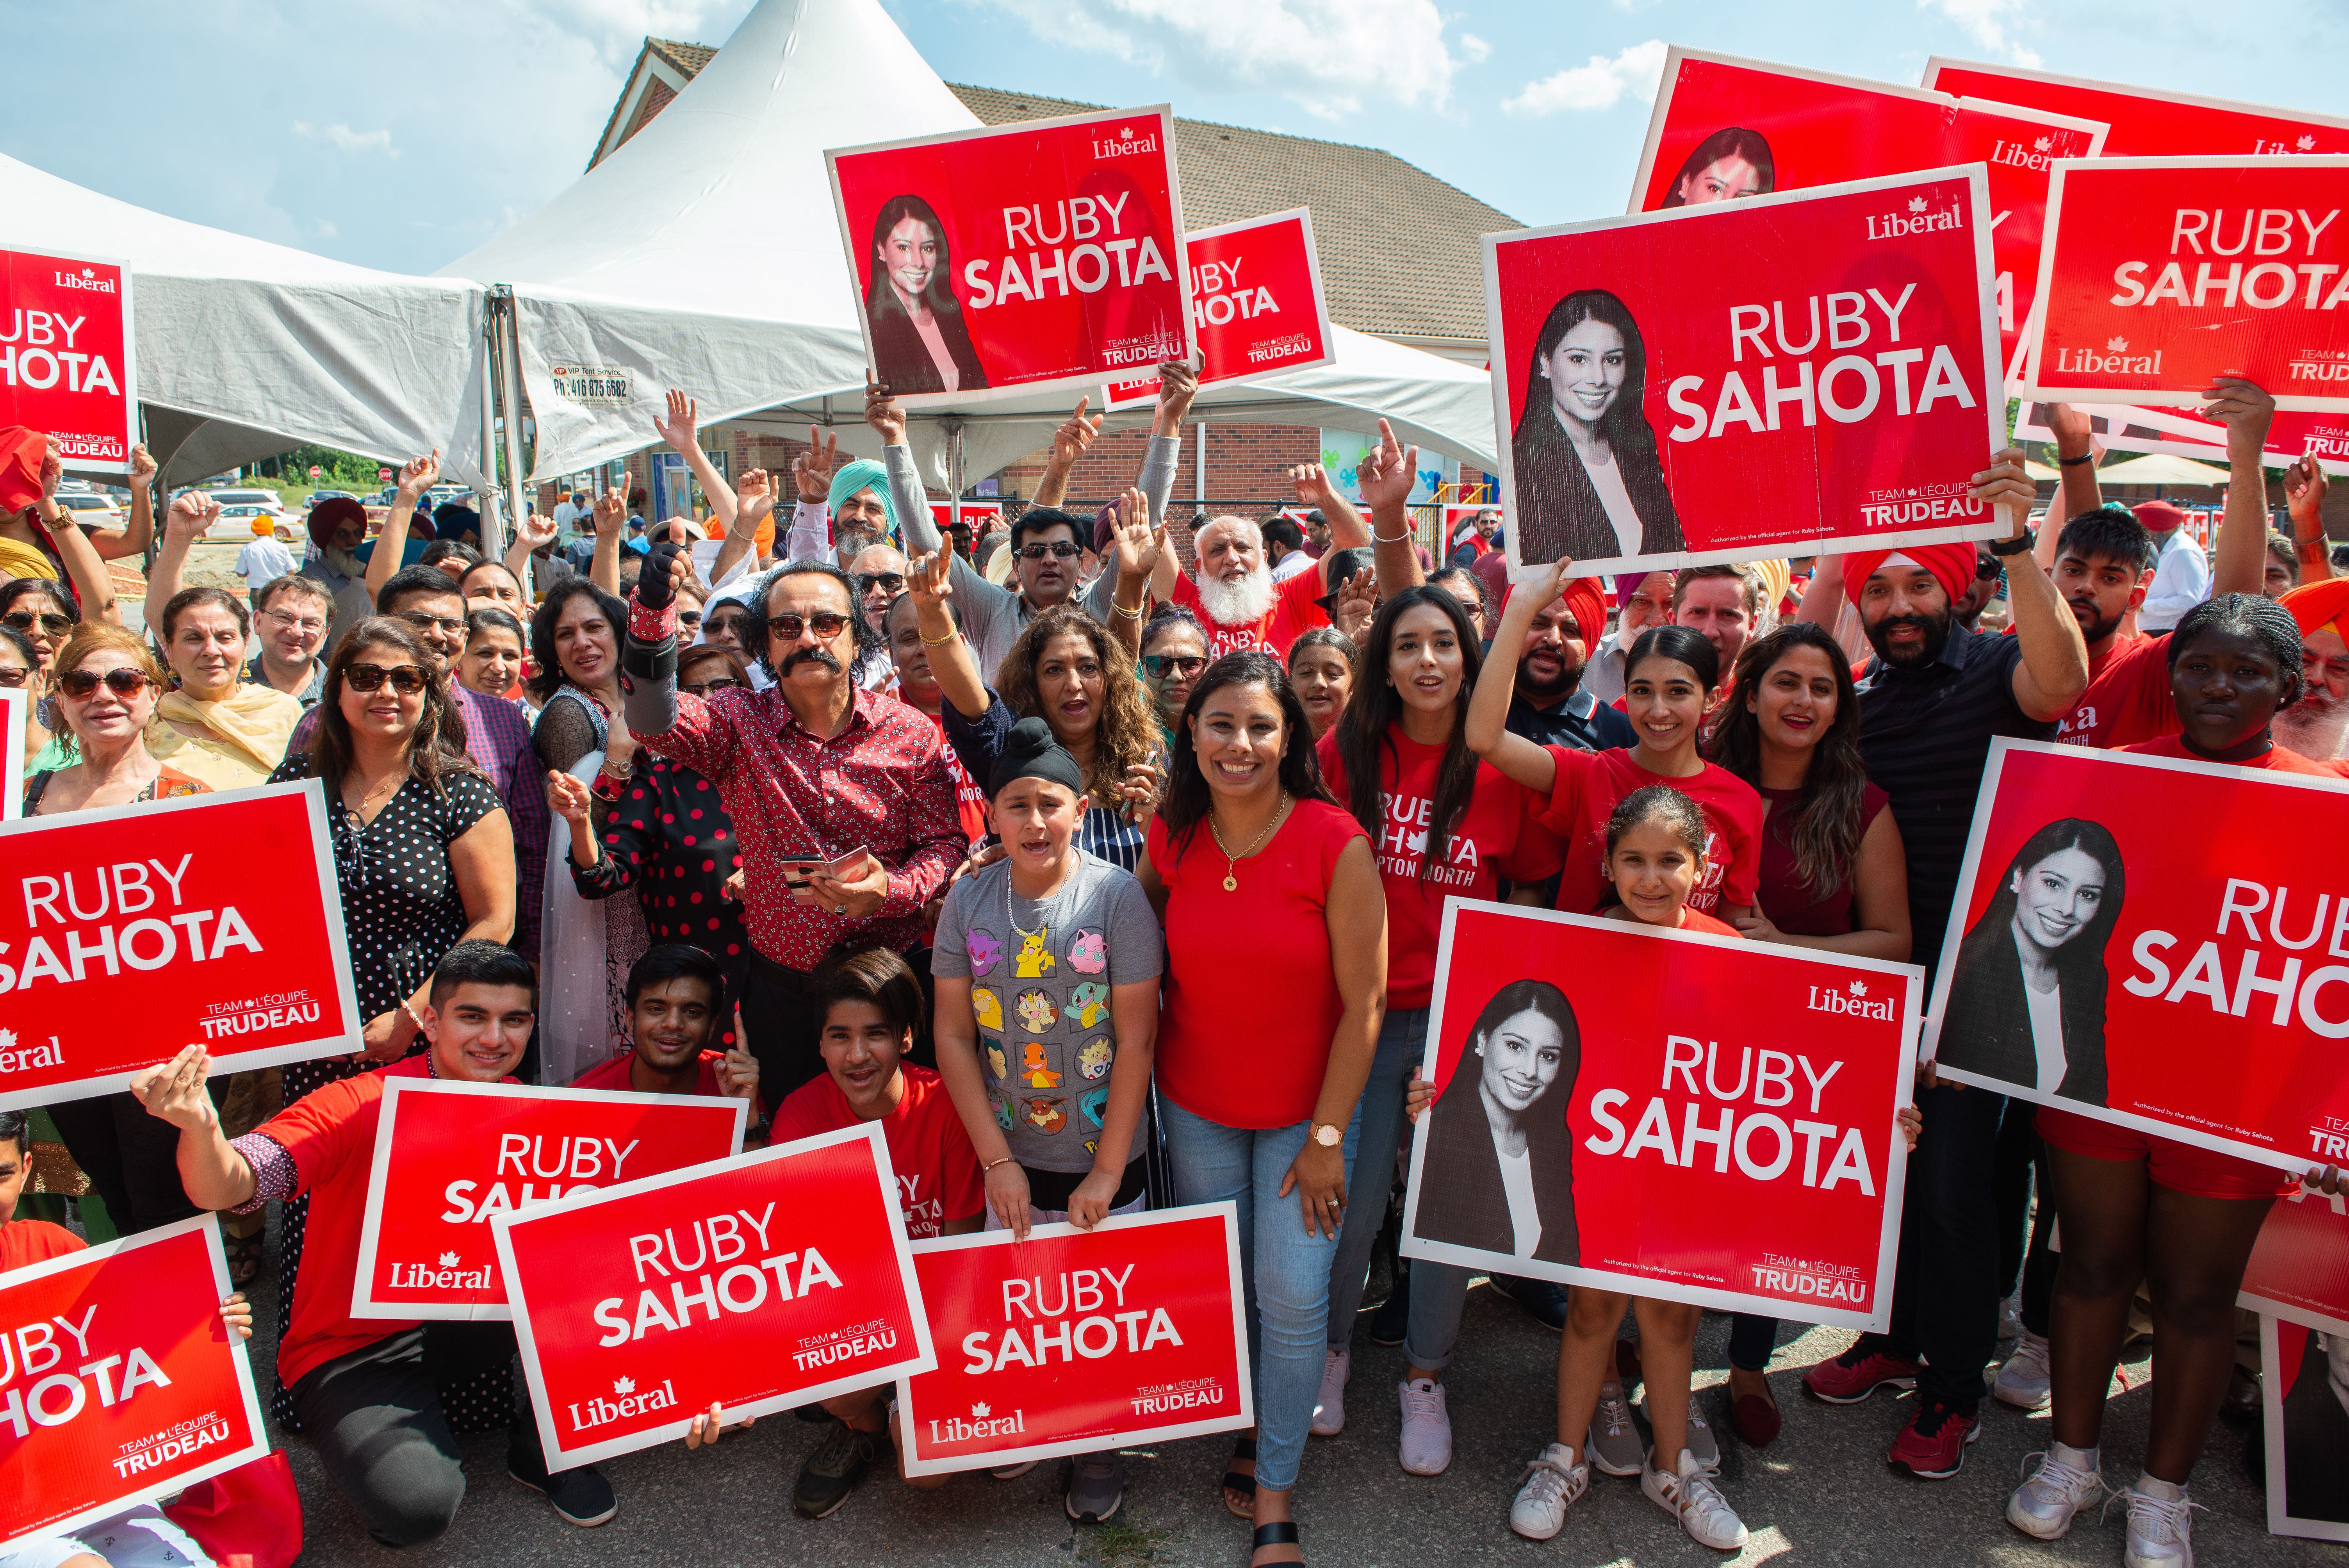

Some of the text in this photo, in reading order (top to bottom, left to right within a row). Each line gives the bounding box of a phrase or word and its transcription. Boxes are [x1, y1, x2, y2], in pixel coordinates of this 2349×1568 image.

[1003, 191, 1129, 249] RUBY
[2171, 209, 2340, 256] RUBY
[965, 236, 1173, 308] SAHOTA
[0, 309, 86, 348] UBY
[1731, 282, 1917, 361] RUBY
[1103, 341, 1180, 365] TRUDEAU
[1107, 338, 1132, 346] TEAM
[1248, 340, 1311, 363] TRUDEAU
[1251, 340, 1270, 349] TEAM
[2301, 349, 2334, 359] TEAM
[572, 379, 586, 397] 416
[589, 380, 604, 397] 875
[606, 380, 626, 397] 6682
[2289, 363, 2349, 381] TRUD
[1667, 344, 1977, 442] SAHOTA
[2314, 426, 2343, 436] TEAM
[59, 442, 122, 457] RUDEAU
[1862, 497, 1982, 526] TRUDEAU
[1869, 488, 1905, 501] TEAM
[22, 853, 193, 927] RUBY
[2123, 930, 2349, 1039] SAHO
[201, 1002, 320, 1039] TRUDEAU
[207, 1000, 242, 1014] TEAM
[1662, 1035, 1844, 1113] RUBY
[2133, 1101, 2165, 1113] Authorized
[2186, 1115, 2205, 1124] official
[2206, 1121, 2223, 1129] agent
[2235, 1127, 2250, 1137] Ruby
[2252, 1131, 2274, 1142] Sahota.
[497, 1134, 640, 1179] RUBY
[1584, 1089, 1876, 1197] SAHOTA
[629, 1202, 776, 1283] RUBY
[1763, 1253, 1797, 1268] TEAM
[1604, 1258, 1631, 1267] Authorized
[593, 1247, 843, 1347] SAHOTA
[1003, 1264, 1135, 1321] RUBY
[1752, 1268, 1866, 1303] TRUDEAU
[793, 1331, 897, 1372] TRUDEAU
[797, 1334, 828, 1349] TEAM
[962, 1308, 1183, 1375] SAHOTA
[1131, 1388, 1223, 1415] TRUDEAU
[1137, 1384, 1164, 1396] TEAM
[114, 1421, 229, 1479] TRUDEAU
[119, 1436, 155, 1454] TEAM
